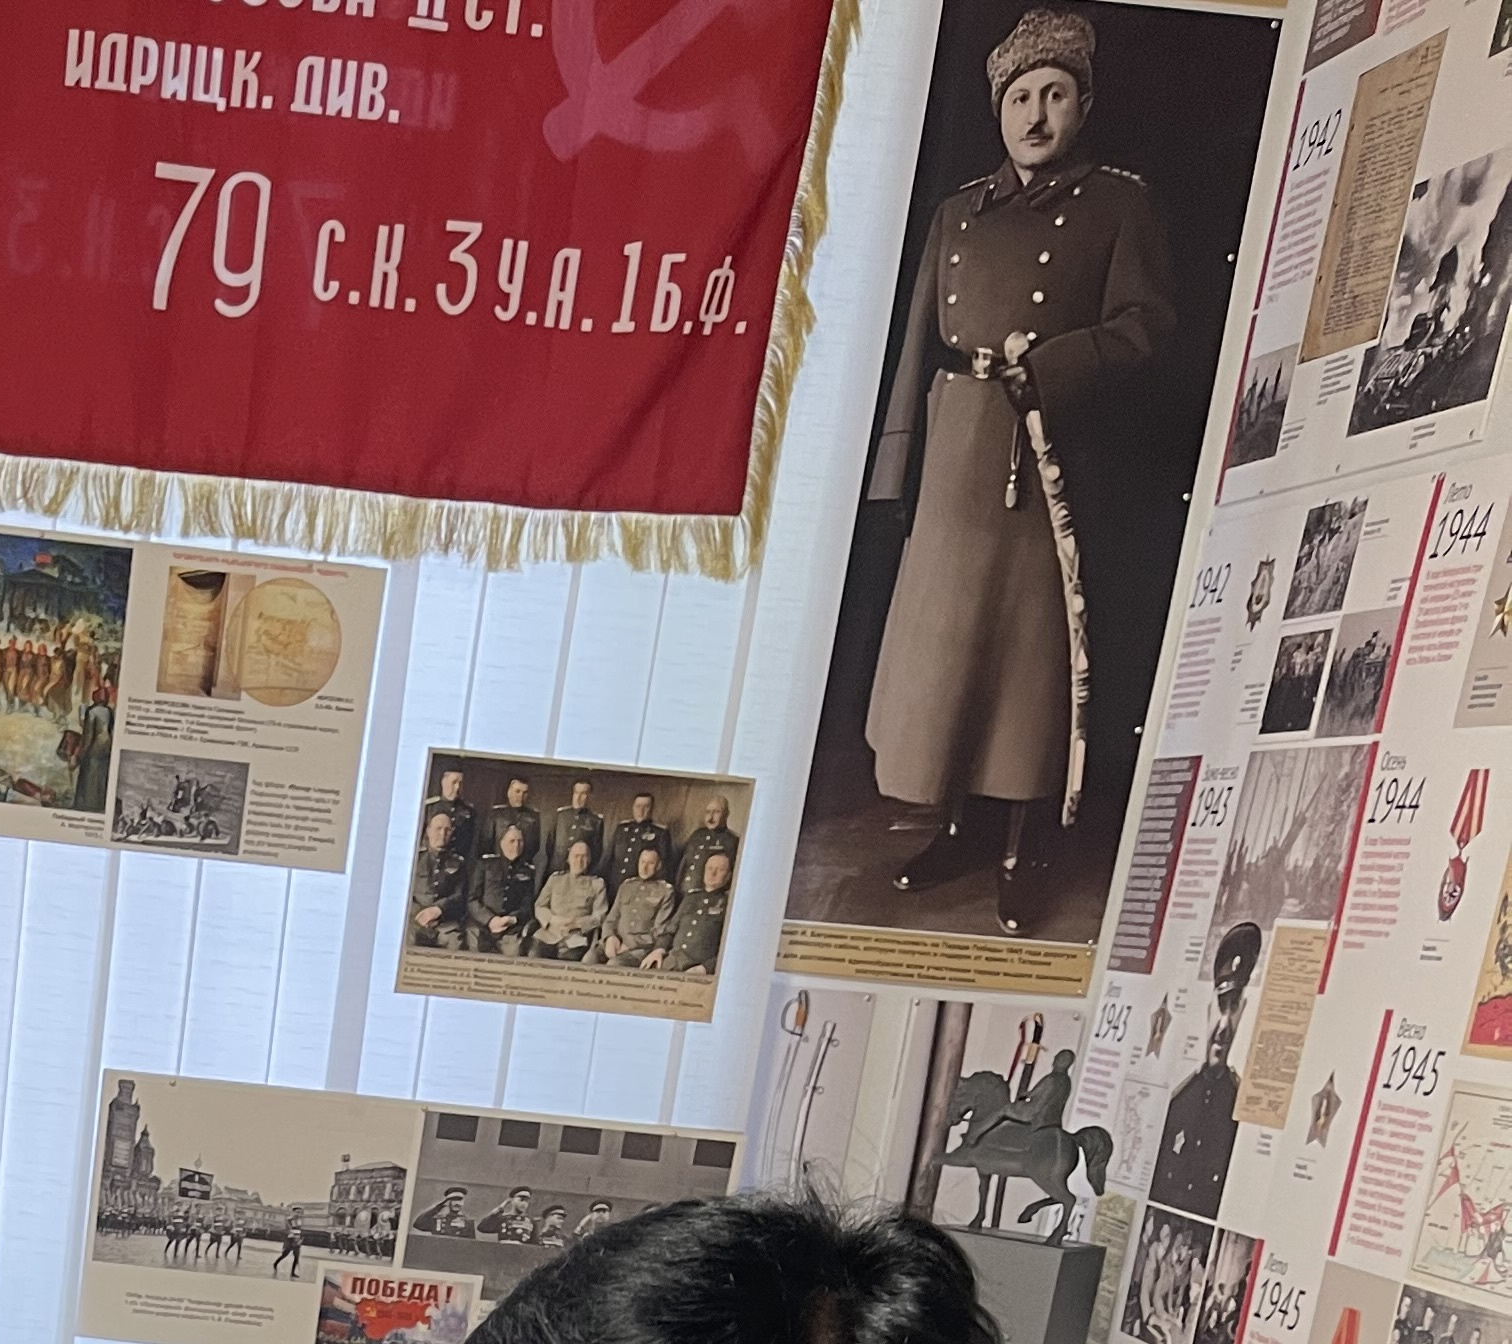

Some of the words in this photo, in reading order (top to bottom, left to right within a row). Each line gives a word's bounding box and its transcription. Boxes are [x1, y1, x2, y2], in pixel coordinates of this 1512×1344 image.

[64, 29, 274, 112] ИДРИЦК.
[291, 55, 400, 124] ДИВ.
[1292, 107, 1343, 171] 1942
[152, 160, 273, 319] 79
[1429, 502, 1496, 560] 1944
[1189, 562, 1232, 609] 1942
[1190, 786, 1234, 827] 1943
[1367, 776, 1427, 824] 1944
[1094, 1003, 1133, 1042] 1943
[1382, 1044, 1447, 1097] 1945
[1253, 1277, 1307, 1331] 1945
